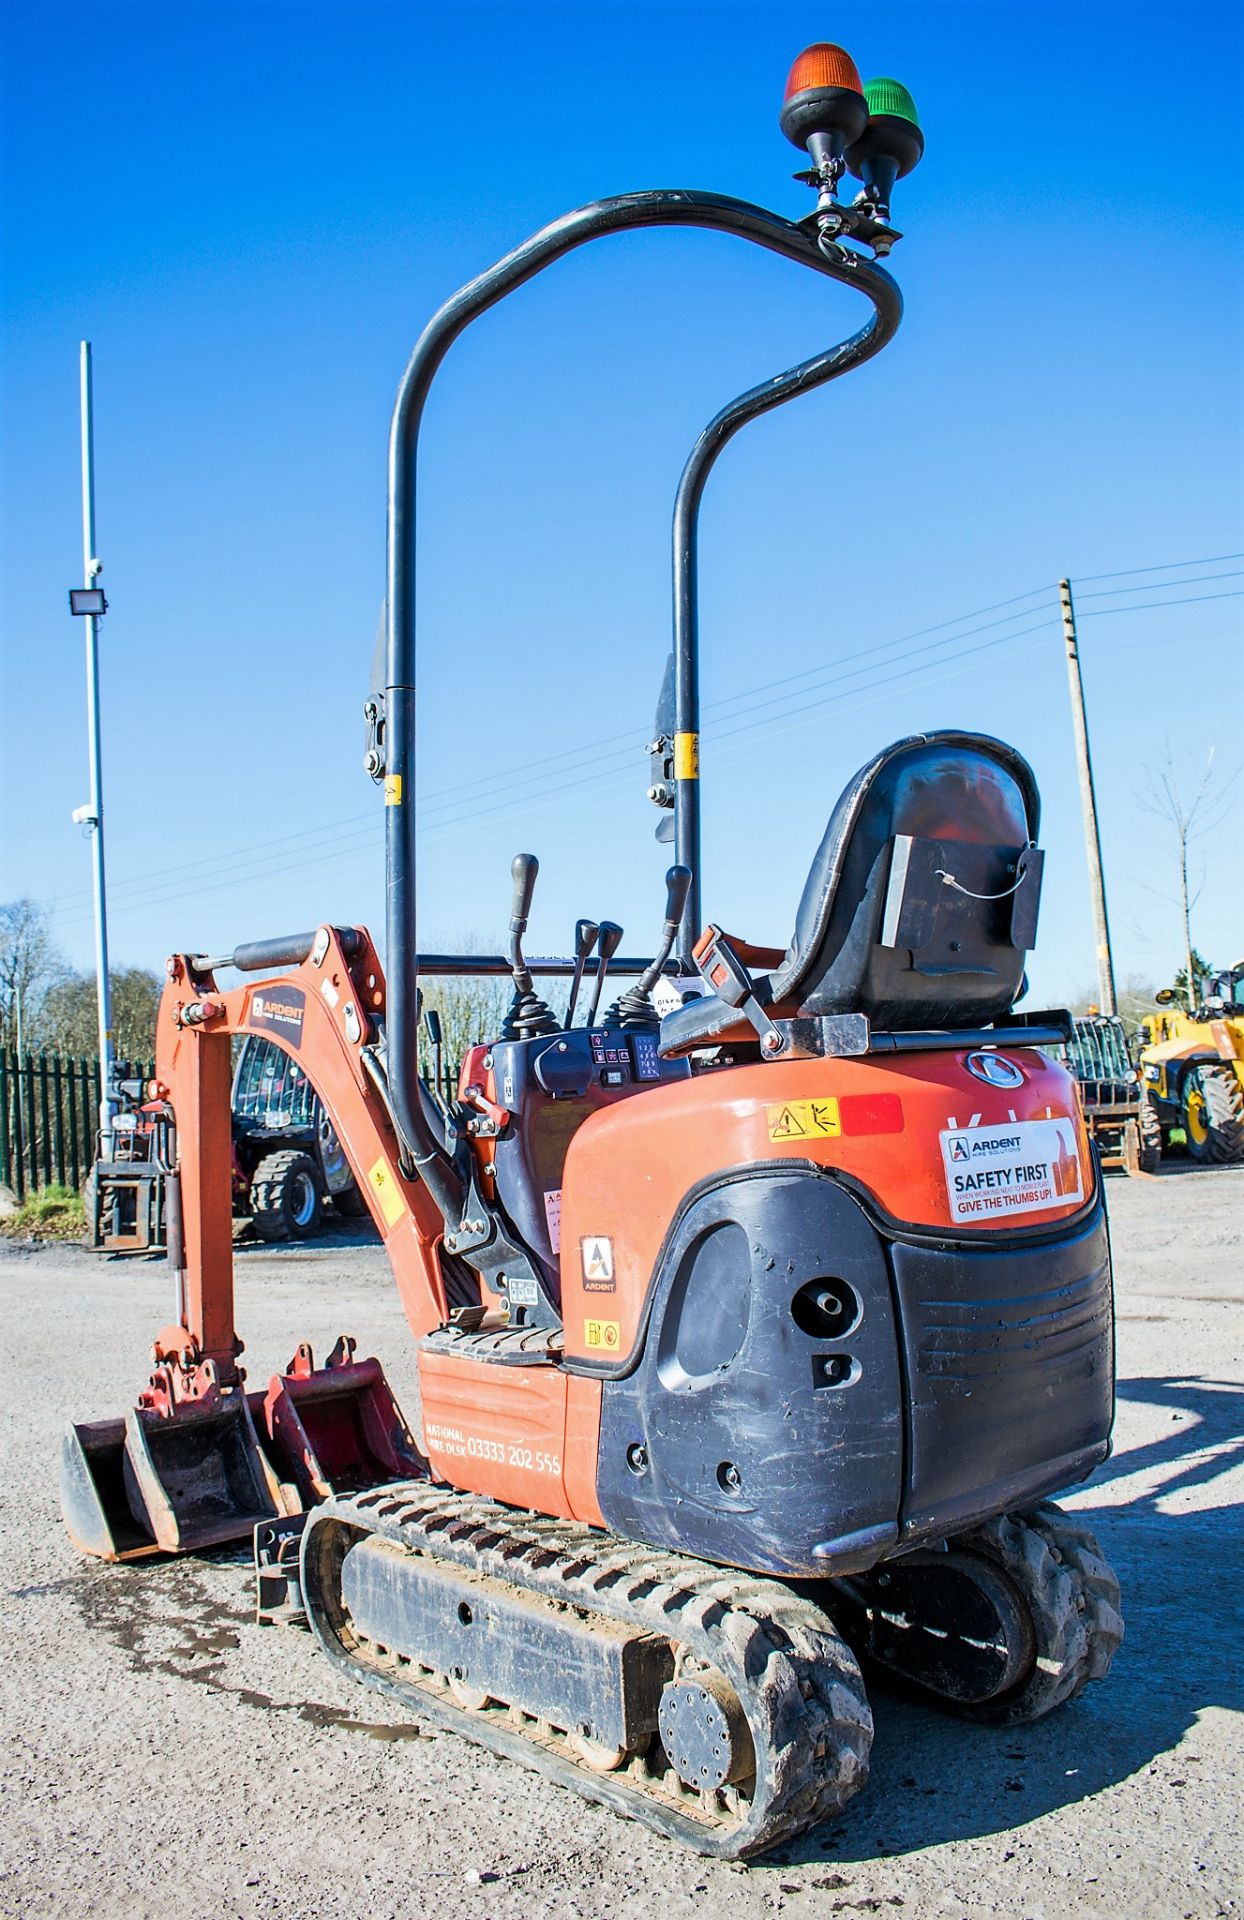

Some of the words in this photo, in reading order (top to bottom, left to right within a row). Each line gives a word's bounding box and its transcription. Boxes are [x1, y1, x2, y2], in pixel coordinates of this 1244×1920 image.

[264, 1001, 304, 1018] ARDENT
[972, 1137, 1021, 1152] ARDENT
[990, 1147, 1021, 1155] SOLUTIONS
[954, 1169, 1013, 1192] SAFETY
[1015, 1164, 1047, 1182] FIRST
[958, 1200, 982, 1213] GIVE
[983, 1198, 1003, 1209] THE
[1004, 1191, 1039, 1205] THUMBS
[1041, 1189, 1052, 1200] UP!
[974, 1189, 999, 1197] WORKING
[585, 1283, 614, 1292] ARDENT
[425, 1423, 465, 1443] NATIONAL
[428, 1439, 445, 1452] HIRE
[446, 1444, 466, 1457] DESK
[467, 1437, 505, 1463] 03333
[508, 1446, 533, 1469] 202
[535, 1452, 561, 1476] 555
